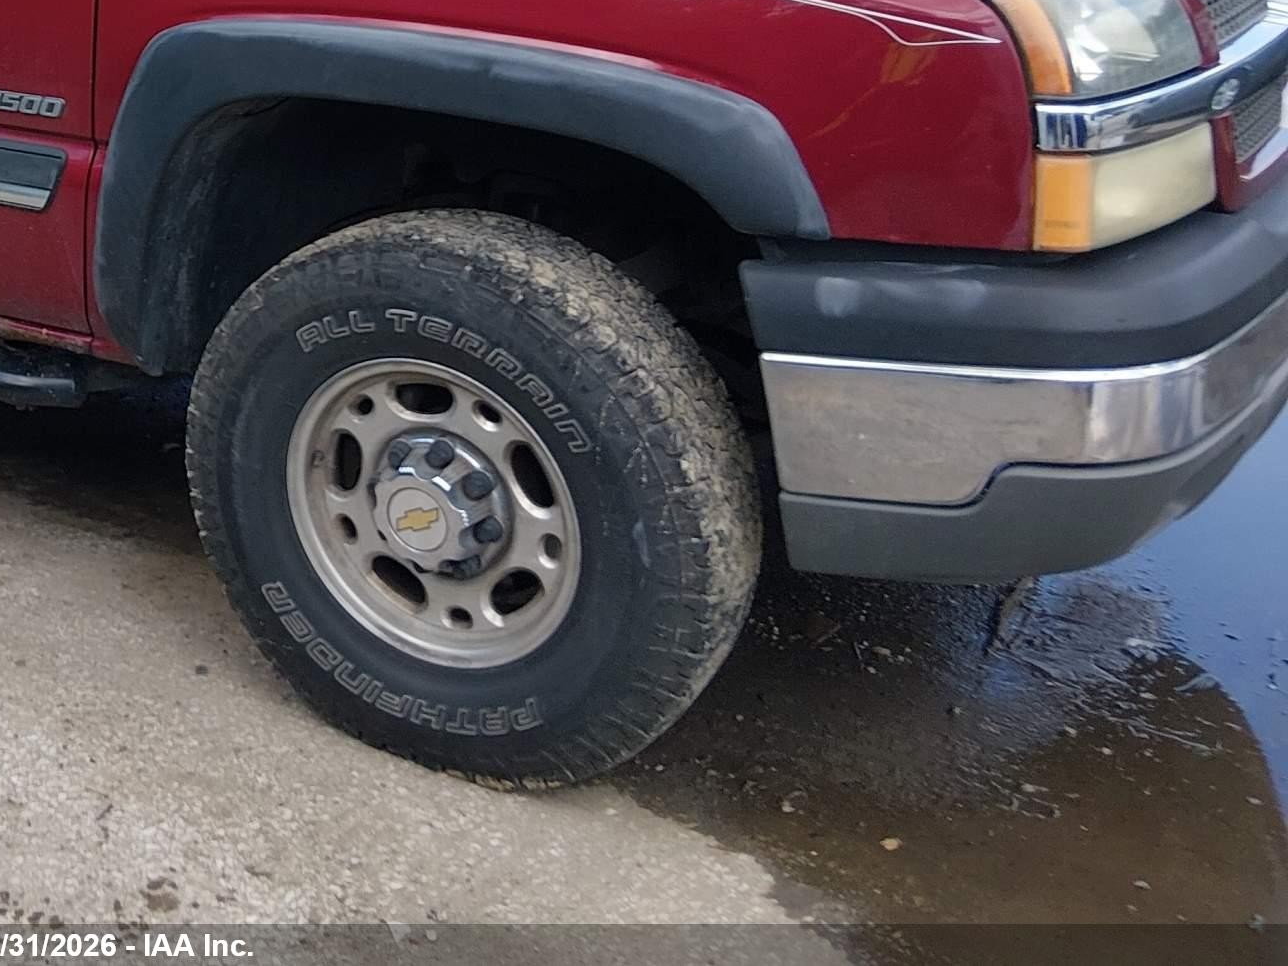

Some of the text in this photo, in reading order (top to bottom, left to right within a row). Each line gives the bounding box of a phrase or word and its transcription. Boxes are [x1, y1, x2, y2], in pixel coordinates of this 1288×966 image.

[294, 307, 594, 455] ALL TERRAIN
[260, 580, 545, 737] PATHFINDER
